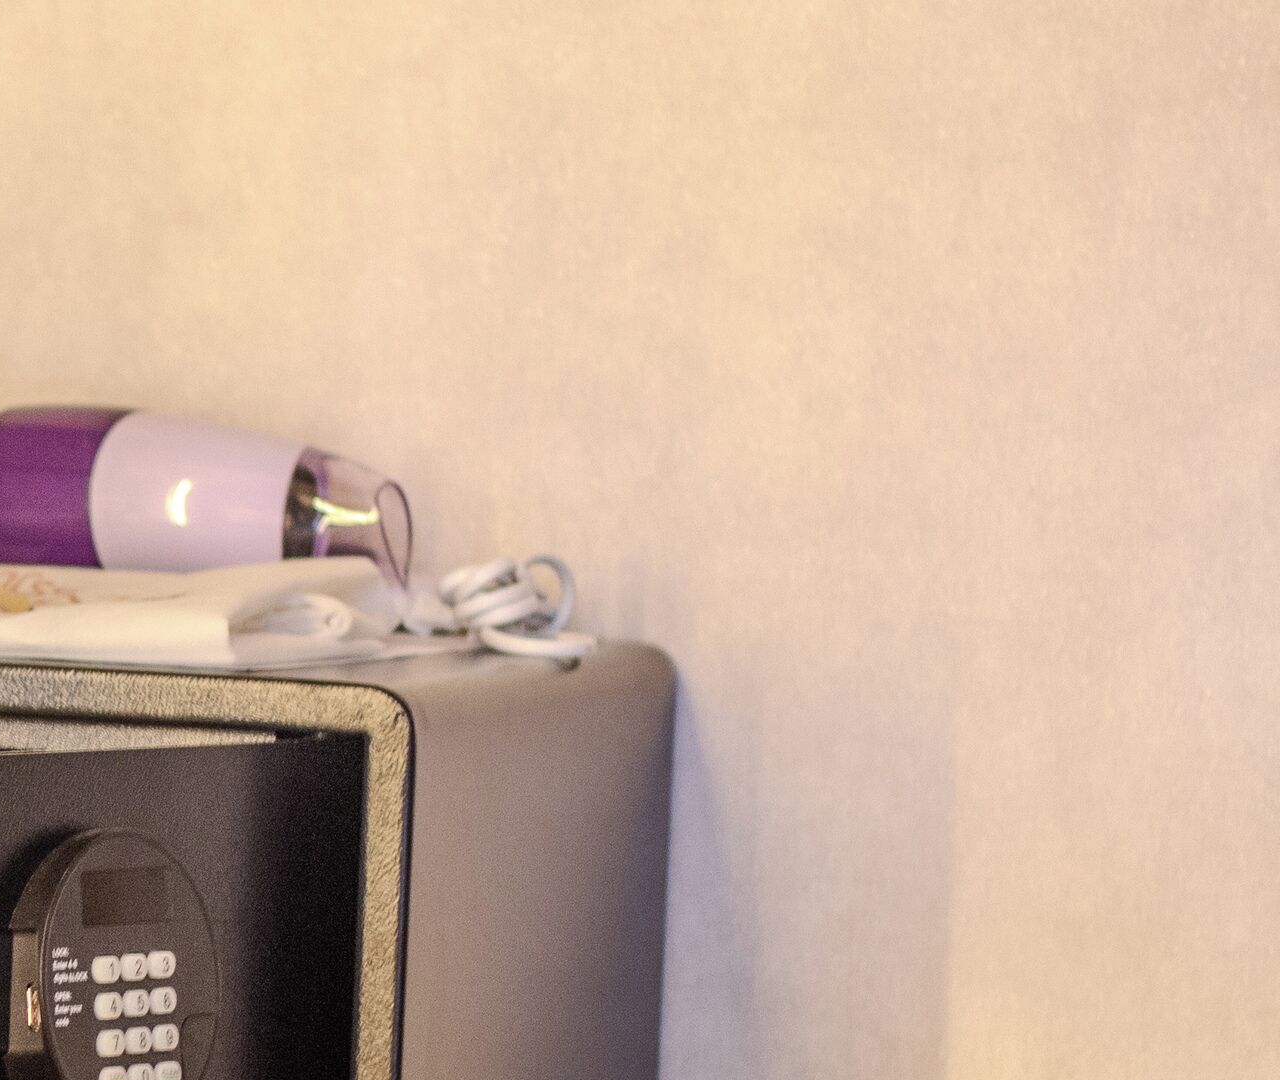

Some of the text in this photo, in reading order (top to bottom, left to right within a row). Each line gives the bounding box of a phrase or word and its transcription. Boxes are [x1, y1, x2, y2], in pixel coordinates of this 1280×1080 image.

[109, 956, 170, 978] 1 2 3
[110, 991, 171, 1015] 4 5 6
[112, 1028, 174, 1051] 7 8 9
